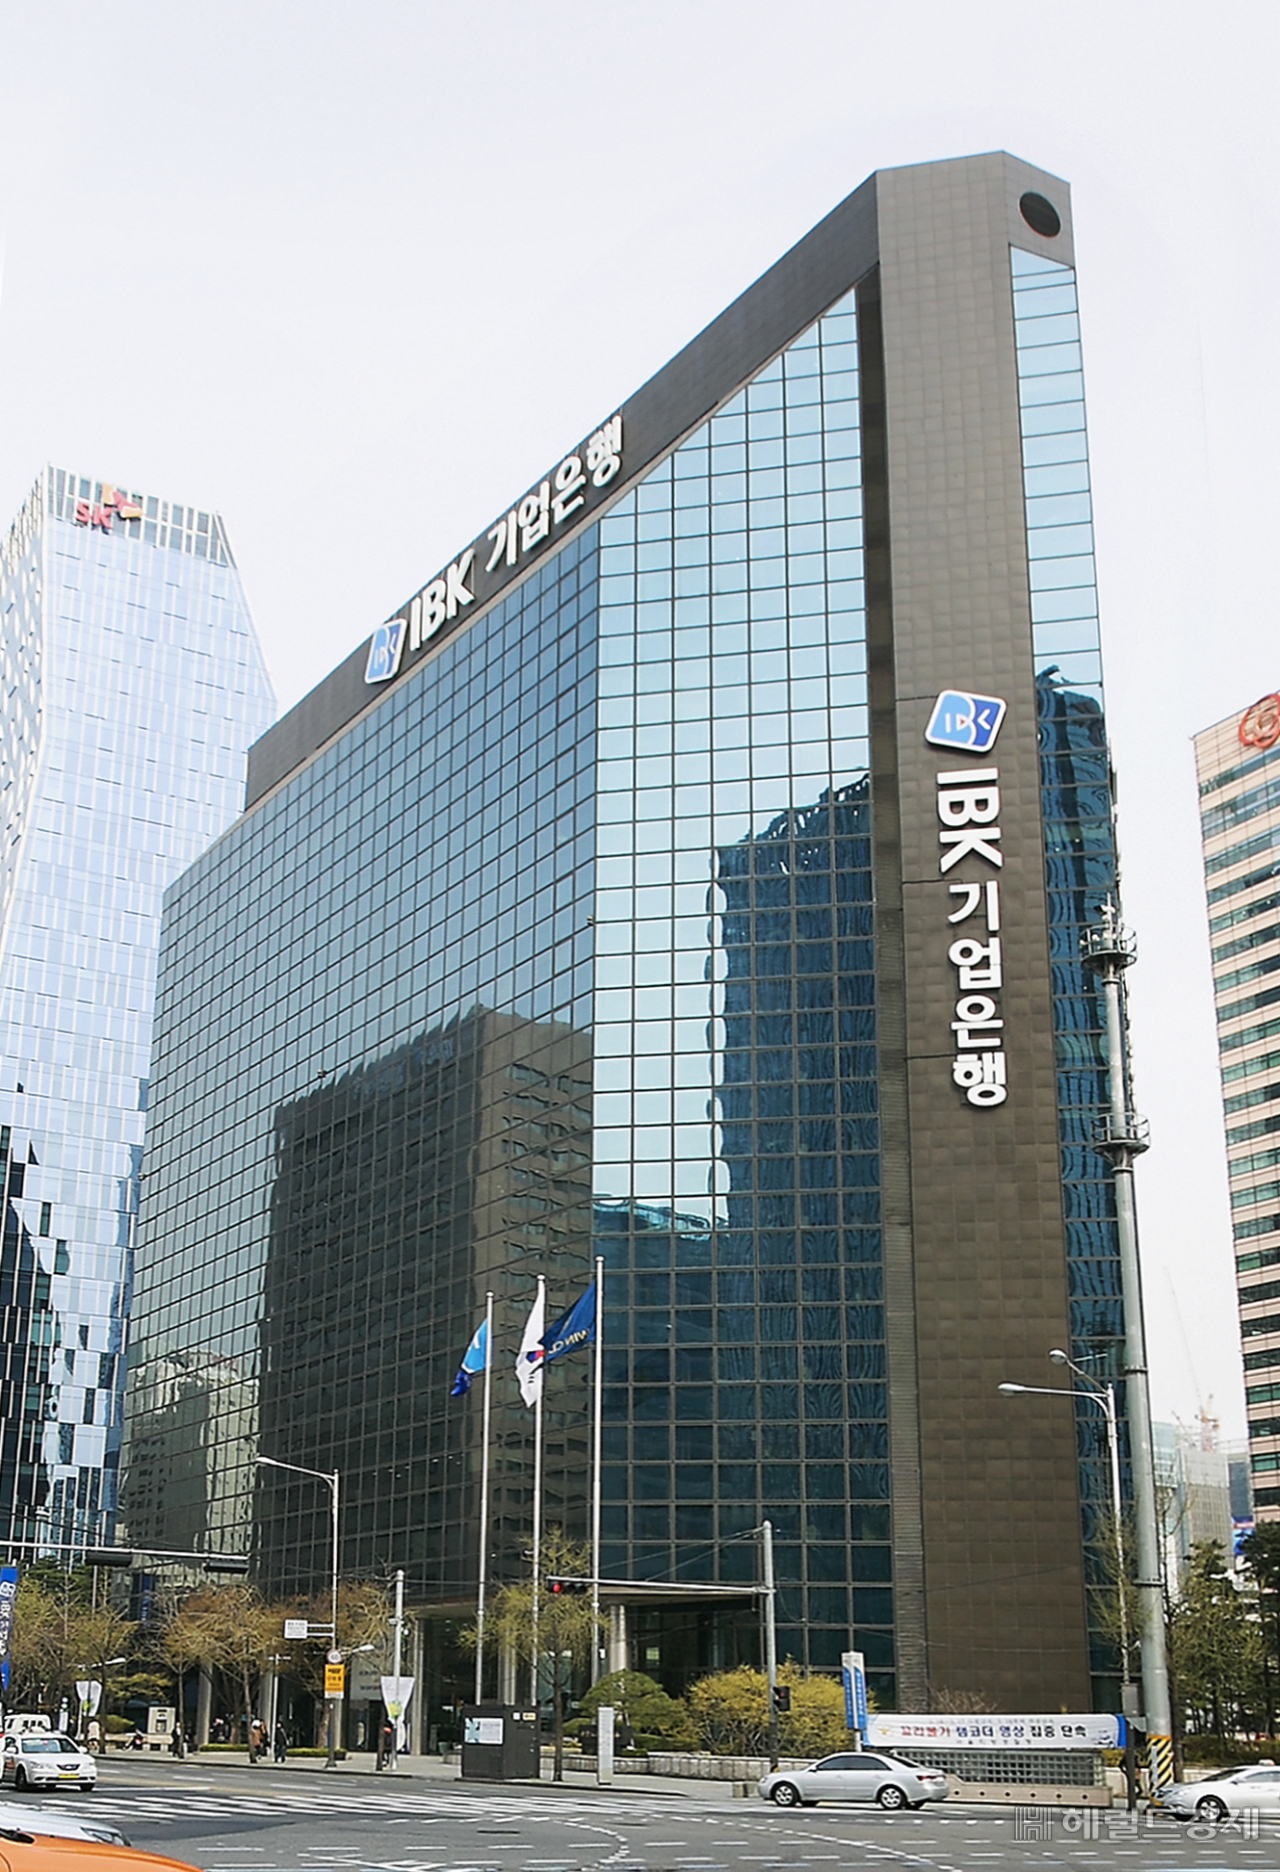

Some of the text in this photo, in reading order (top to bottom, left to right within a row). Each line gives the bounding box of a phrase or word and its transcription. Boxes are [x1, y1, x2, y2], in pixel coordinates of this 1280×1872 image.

[77, 502, 113, 529] SK
[410, 414, 623, 652] IBK 기업은행
[936, 767, 1008, 1107] IBK 기업은행
[999, 1725, 1025, 1738] 영상
[1030, 1725, 1055, 1738] 집중
[1061, 1725, 1087, 1737] 단속
